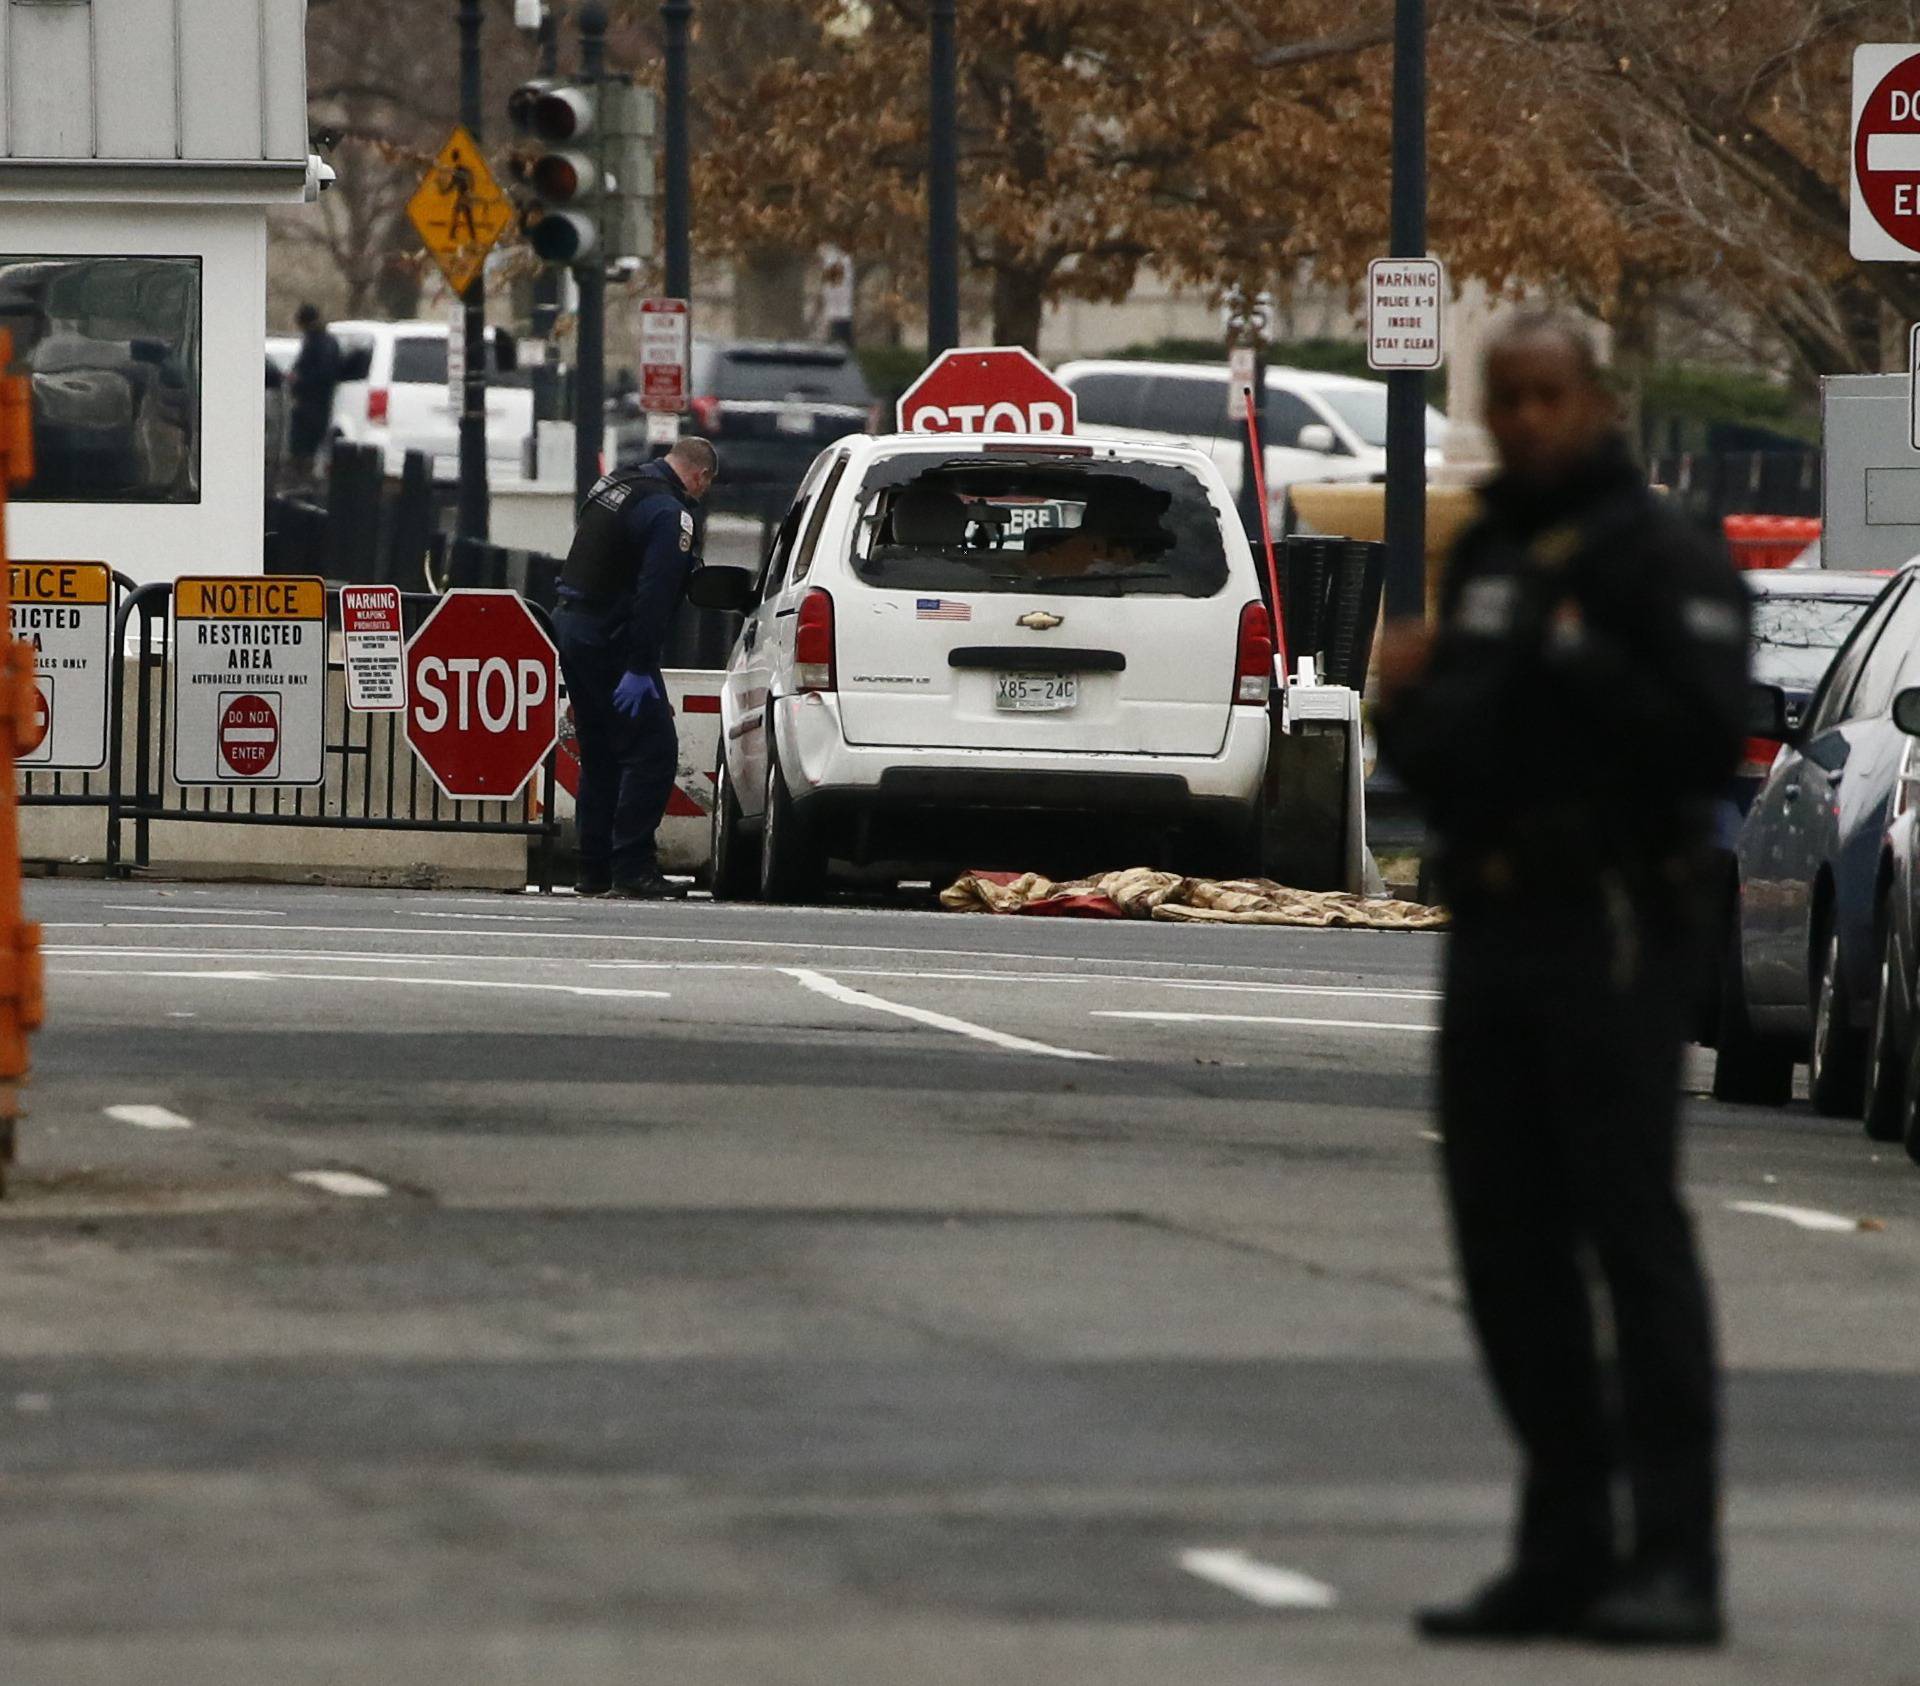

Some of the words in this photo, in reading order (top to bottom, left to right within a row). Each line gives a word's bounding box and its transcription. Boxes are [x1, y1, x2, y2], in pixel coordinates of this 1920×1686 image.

[1376, 273, 1436, 287] WARNING
[1377, 297, 1409, 307] POLICE
[1388, 317, 1422, 328] INSIDE
[1376, 338, 1398, 349] STAY
[1404, 338, 1434, 349] CLEAR
[7, 567, 77, 598] TICE
[200, 584, 299, 615] NOTICE
[346, 593, 396, 610] WARNING
[7, 607, 81, 629] RICTED
[198, 624, 302, 646] RESTRICTED
[62, 658, 87, 669] ONLY
[228, 649, 273, 670] AREA
[192, 674, 242, 685] AUTHORIZED
[246, 674, 284, 685] VEHICLES
[288, 674, 308, 685] ONLY
[415, 656, 547, 733] STOP
[229, 711, 243, 724] DO
[249, 711, 270, 724] NOT
[232, 747, 266, 760] ENTER
